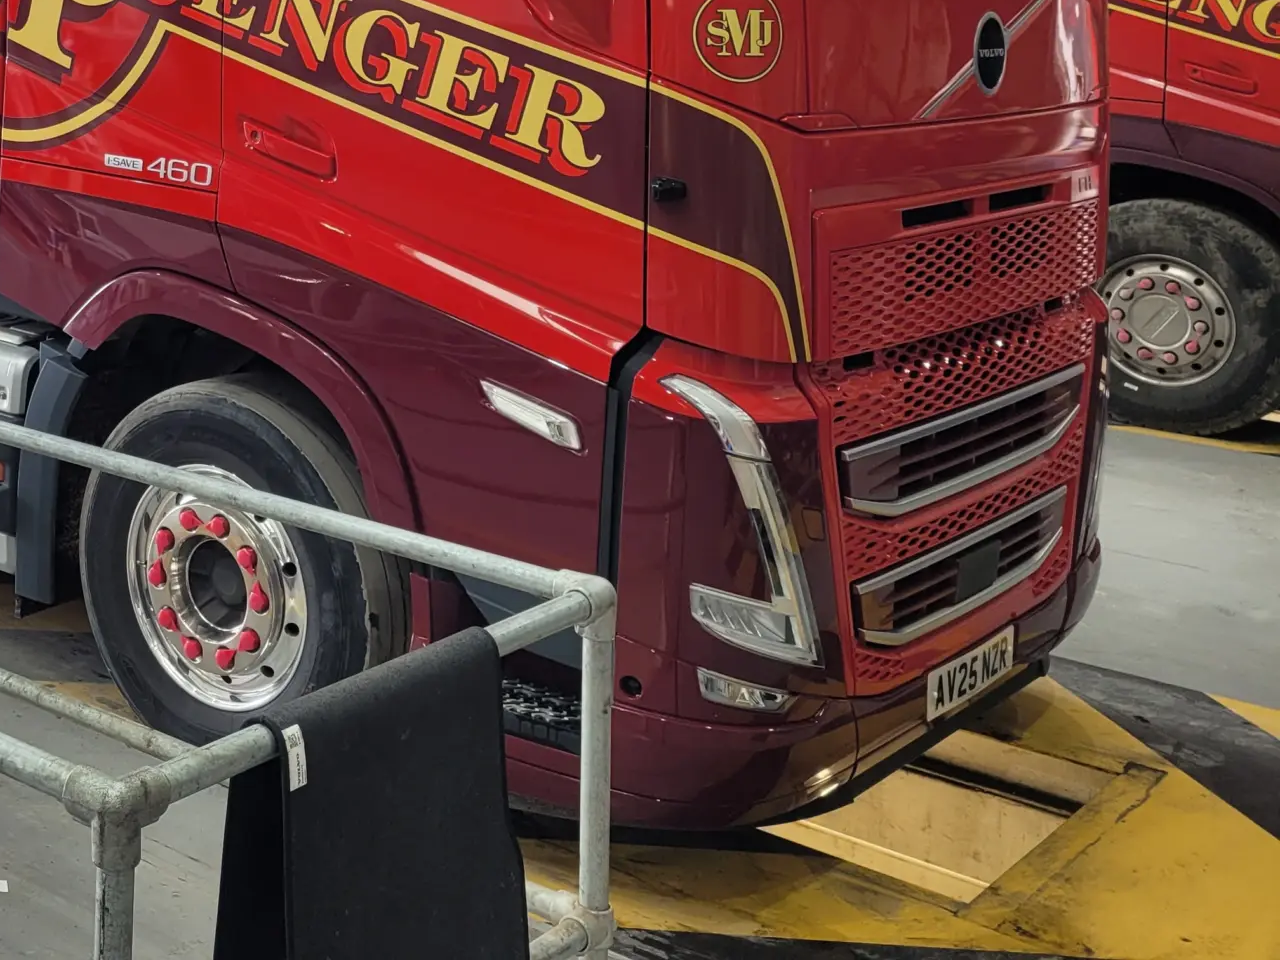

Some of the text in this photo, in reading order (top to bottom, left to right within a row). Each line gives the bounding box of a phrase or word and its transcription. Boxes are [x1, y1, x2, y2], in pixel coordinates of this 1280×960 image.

[706, 8, 775, 57] SMJ
[979, 48, 1004, 57] VOLVO
[147, 157, 213, 186] 460
[935, 635, 1008, 711] AV25 NZR
